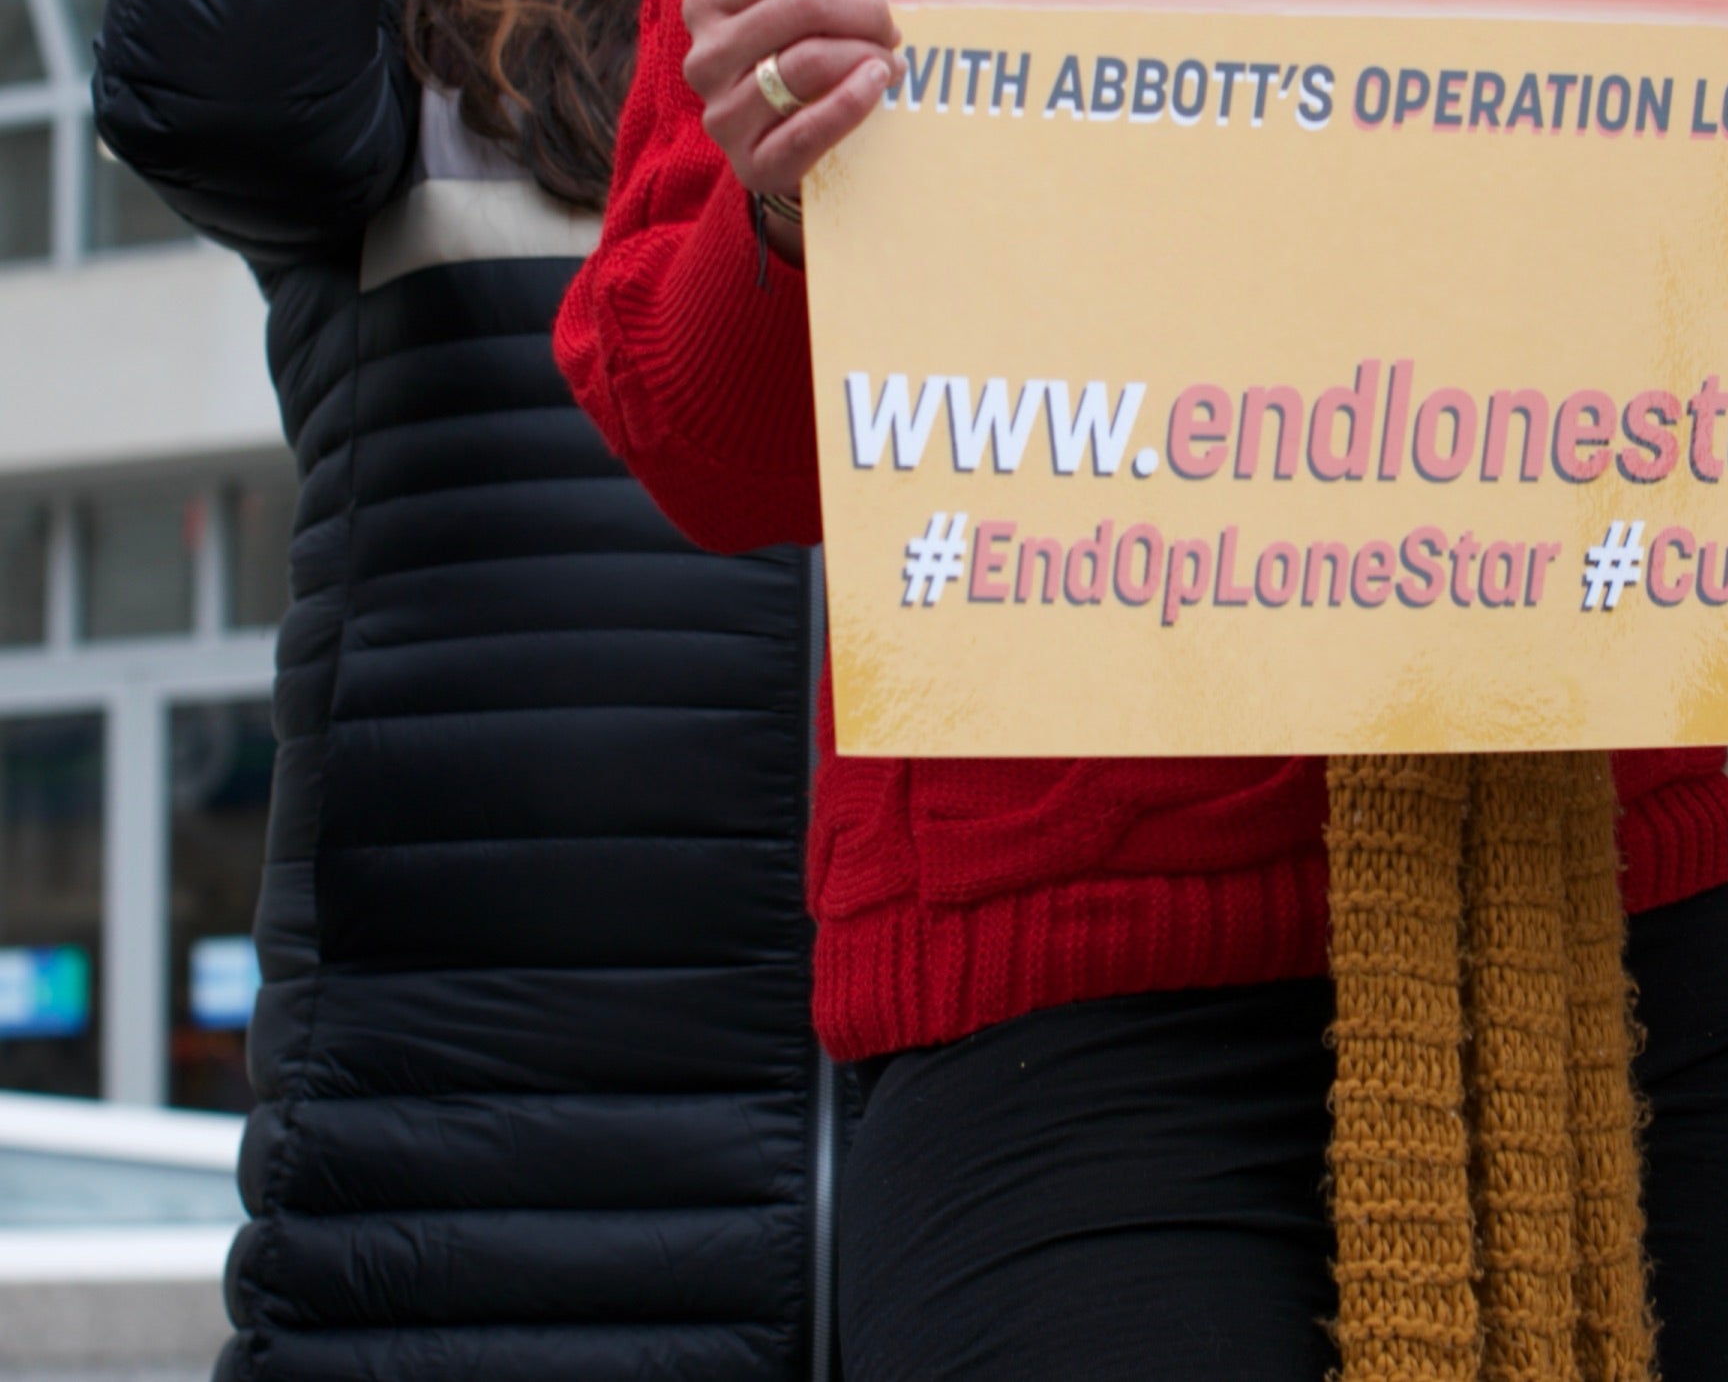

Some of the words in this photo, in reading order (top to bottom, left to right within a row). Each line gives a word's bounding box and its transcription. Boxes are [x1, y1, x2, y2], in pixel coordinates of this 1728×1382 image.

[881, 45, 1033, 117] WITH
[1043, 53, 1336, 132] ABBOTT'S
[1351, 64, 1675, 141] OPERATION
[901, 511, 1563, 628] #EndOpLoneStar
